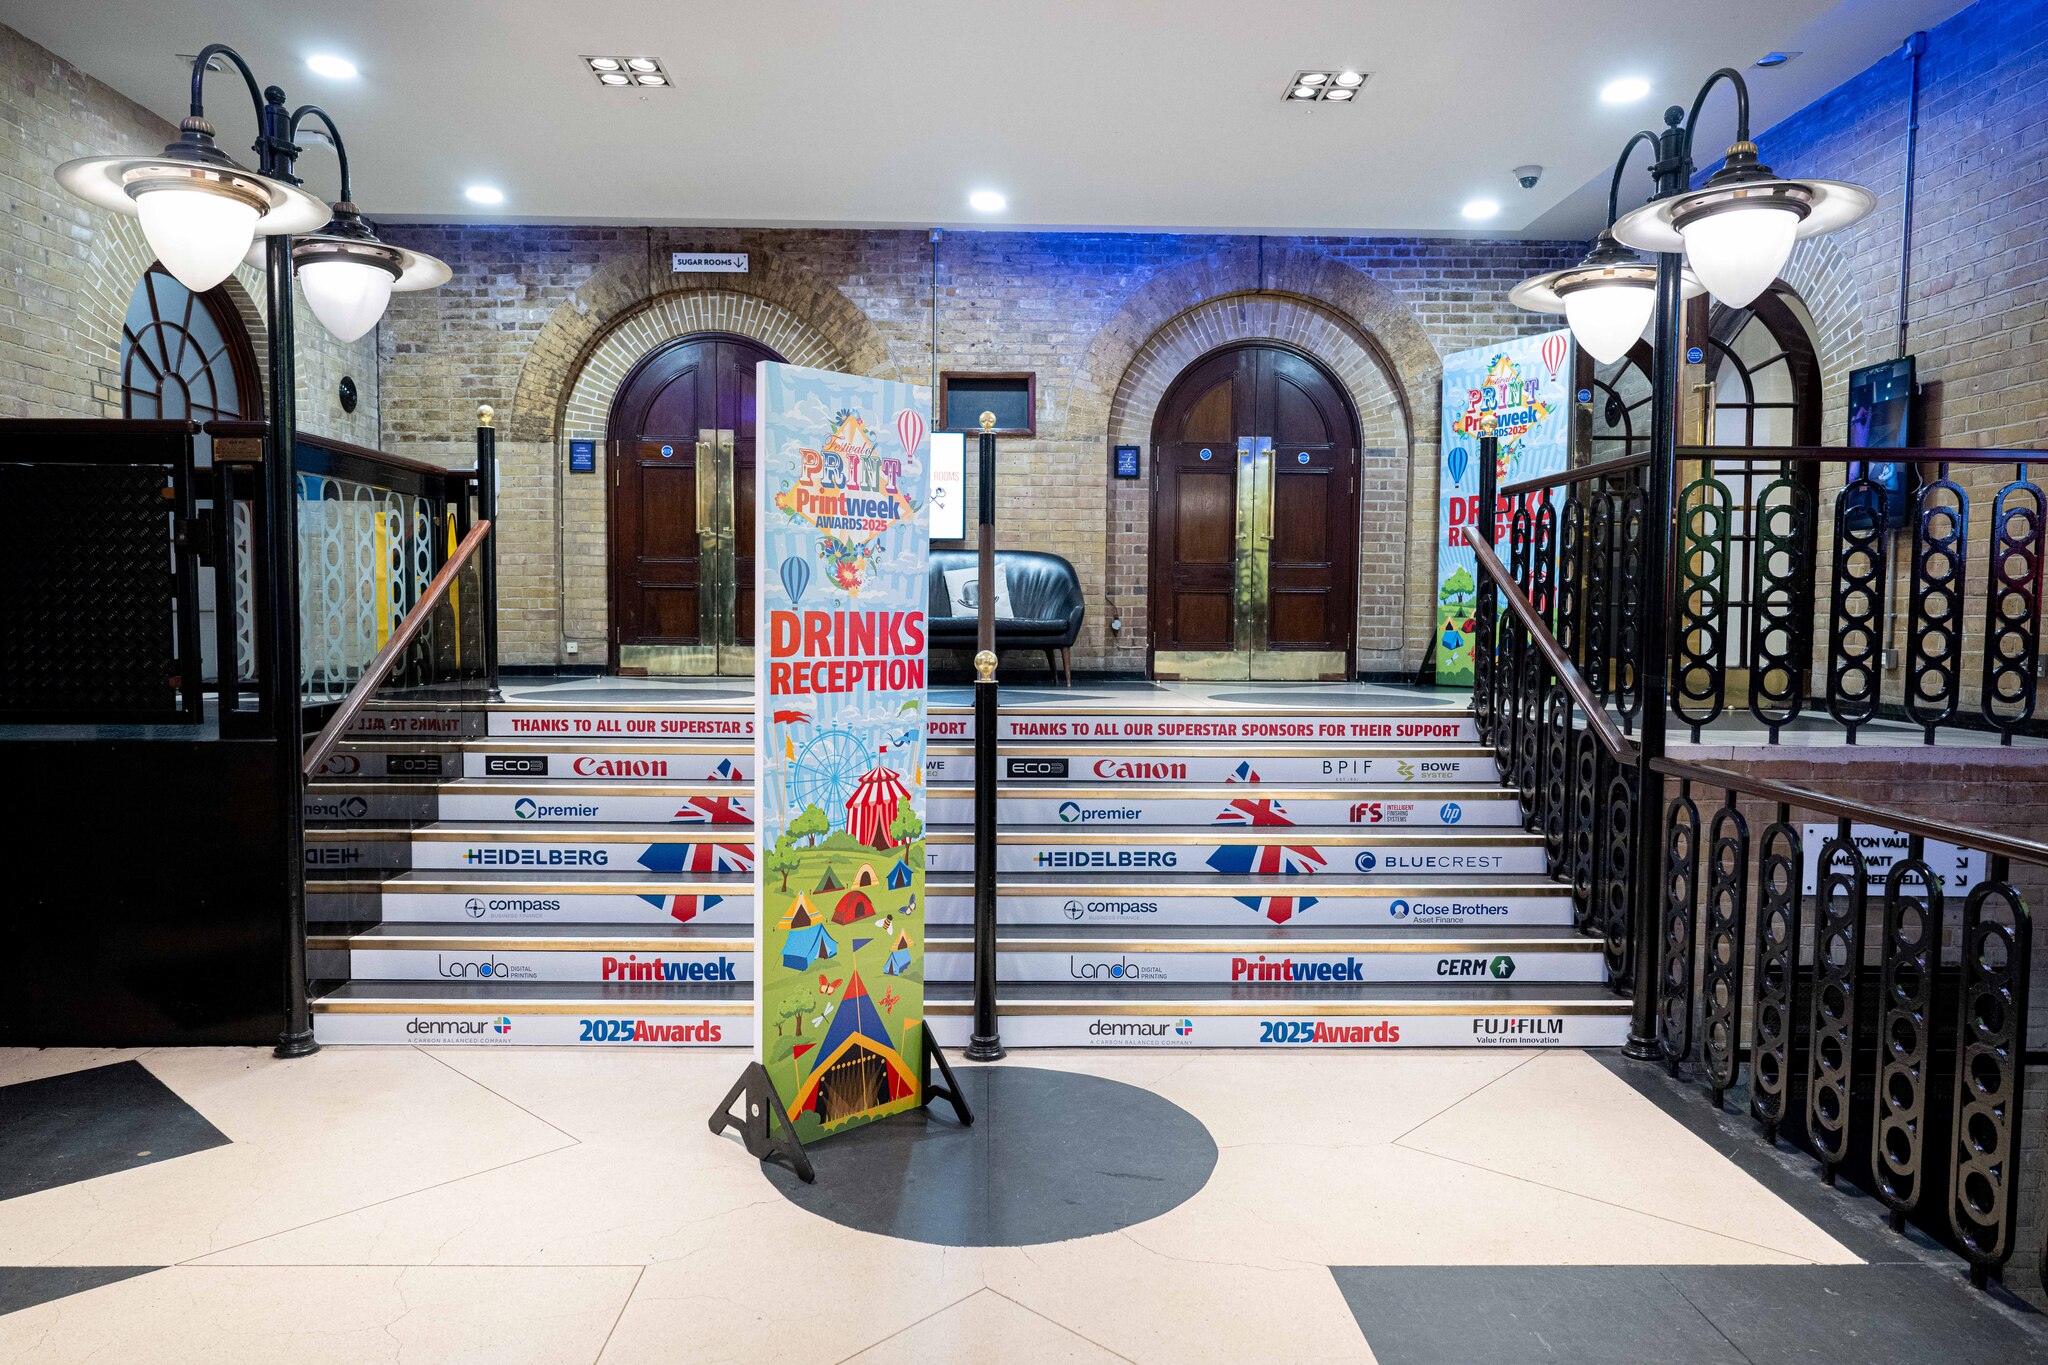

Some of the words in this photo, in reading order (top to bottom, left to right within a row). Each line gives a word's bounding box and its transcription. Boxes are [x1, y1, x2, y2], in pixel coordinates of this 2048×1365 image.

[1467, 377, 1539, 414] PRINT
[1465, 406, 1538, 432] Priweek
[1477, 425, 1527, 439] ARDS2025
[822, 432, 866, 454] Festival
[865, 443, 878, 458] of
[799, 448, 901, 494] PRINT
[934, 471, 959, 481] ROOMS
[797, 487, 900, 520] Printweek
[816, 516, 887, 531] AWARDS2025
[770, 611, 925, 658] DRINKS
[770, 658, 924, 695] RECEPTION
[512, 719, 569, 732] THANKS
[574, 719, 592, 732] TO
[596, 720, 622, 732] ALL
[627, 720, 656, 733] OUR
[660, 720, 741, 734] SUPERSTAR
[927, 722, 966, 735] PORT
[1010, 722, 1067, 736] THANKS
[1072, 722, 1089, 736] TO
[1094, 722, 1119, 736] ALL
[1124, 722, 1153, 736] OUR
[1158, 723, 1237, 737] SUPERSTAR
[1241, 723, 1314, 737] SPONSORS
[1319, 724, 1346, 737] FOR
[1351, 724, 1392, 737] THEIR
[1396, 724, 1460, 737] SUPPORT
[573, 756, 667, 776] Canon
[1093, 759, 1187, 779] Canon
[1322, 760, 1372, 774] BPIF
[1421, 762, 1460, 771] BOWE
[537, 803, 599, 819] premier
[1081, 807, 1142, 822] premier
[1349, 803, 1383, 822] IFS
[1443, 803, 1460, 824] hp
[1823, 837, 1880, 848] STON
[1881, 837, 1910, 848] VAUL
[464, 849, 608, 866] HEIDELBERG
[1034, 851, 1177, 867] HEIDELBERG
[1385, 856, 1503, 868] BLUECREST
[1865, 856, 1892, 866] WATT
[489, 900, 560, 912] compass
[1087, 902, 1158, 915] compass
[1413, 903, 1450, 915] Close
[1452, 904, 1508, 915] Brothers
[439, 953, 509, 978] Landa
[602, 954, 736, 981] Printweek
[1070, 955, 1140, 979] Landa
[1231, 955, 1364, 981] Printweek
[1436, 959, 1487, 976] CERM
[406, 1017, 488, 1034] denmaur
[580, 1019, 722, 1042] 2025Awards
[1089, 1019, 1170, 1036] denmaur
[1260, 1020, 1399, 1043] 2025Awards
[1473, 1018, 1563, 1034] FUJIFILM
